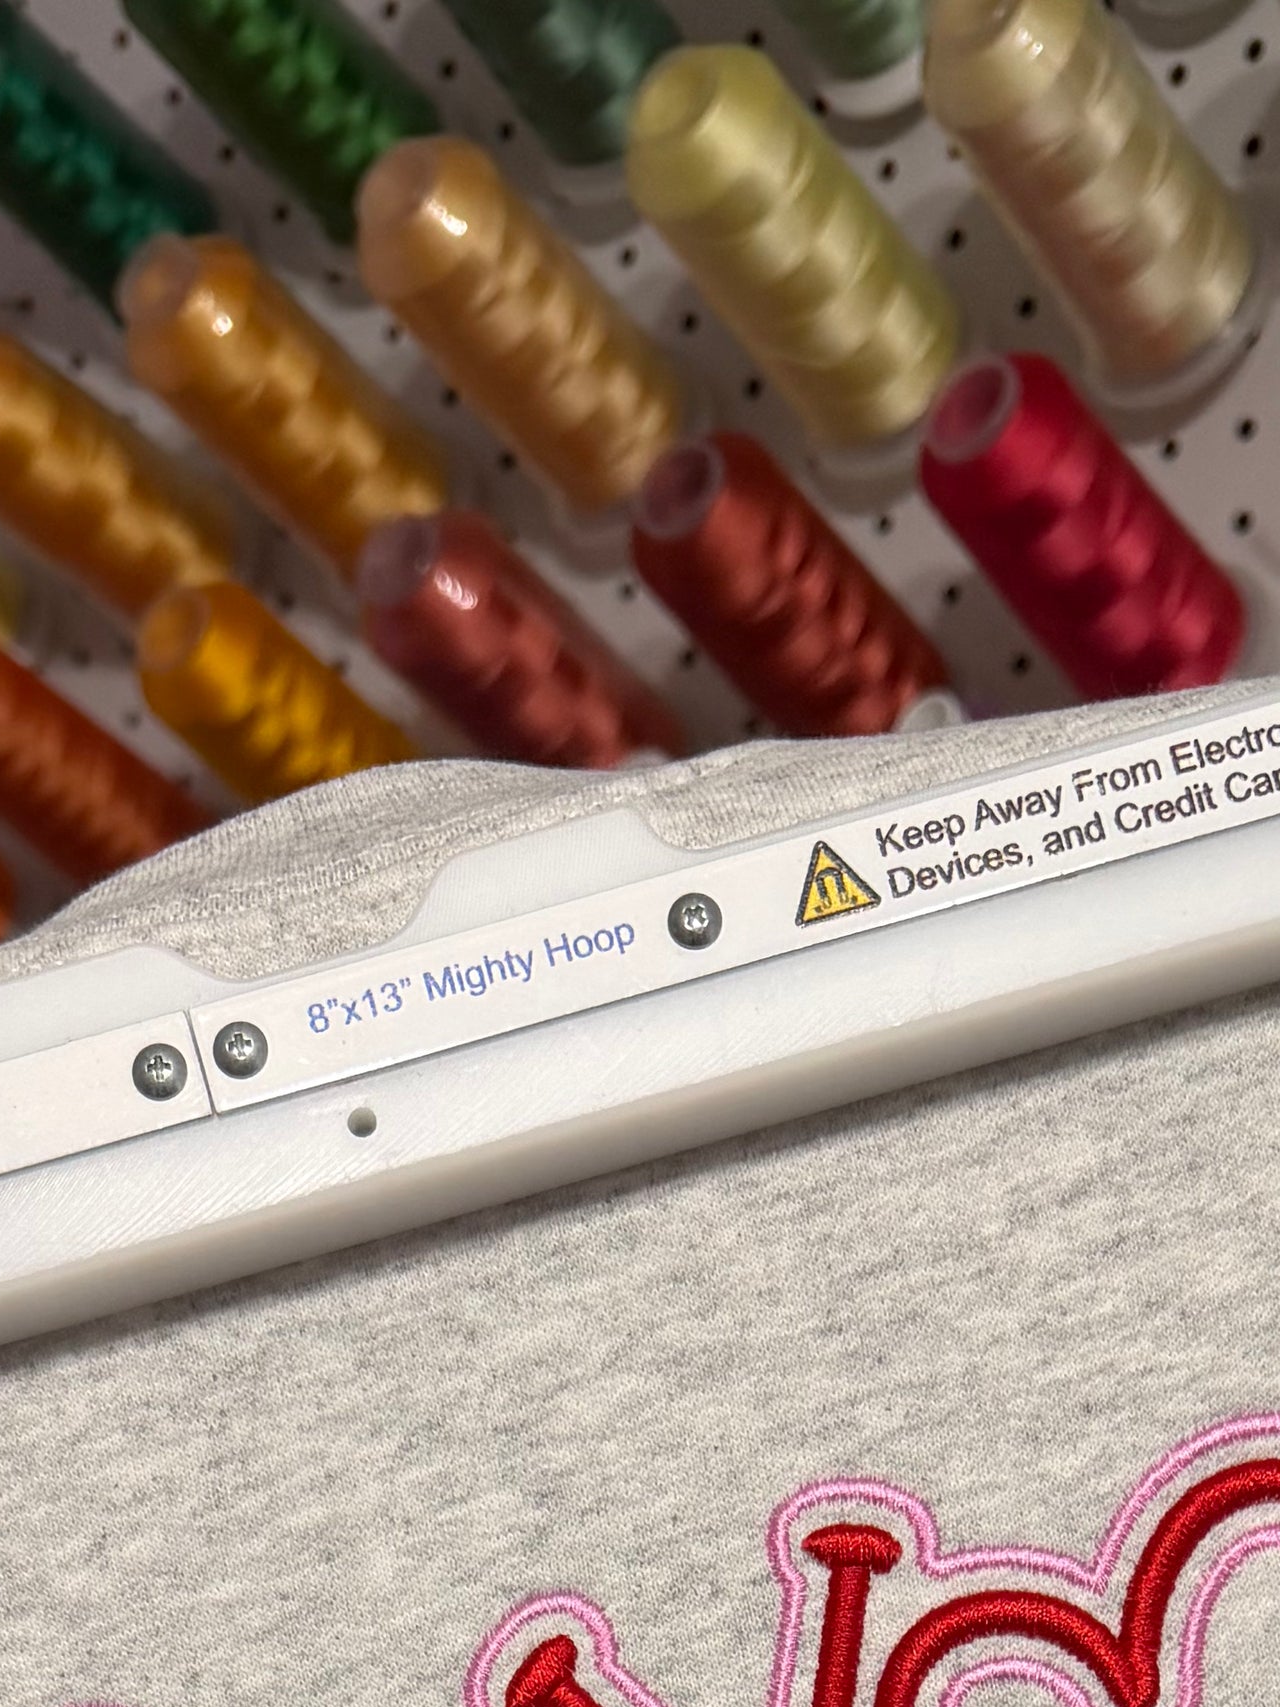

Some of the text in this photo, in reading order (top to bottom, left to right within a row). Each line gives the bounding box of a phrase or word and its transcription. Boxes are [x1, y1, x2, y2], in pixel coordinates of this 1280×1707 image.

[875, 813, 966, 858] Keep
[974, 785, 1063, 832] Away
[1071, 758, 1163, 803] From
[886, 842, 1034, 899] Devices,
[1042, 810, 1107, 856] and
[1114, 782, 1218, 834] Credit
[422, 949, 533, 1002] Mighty
[543, 922, 635, 967] Hoop
